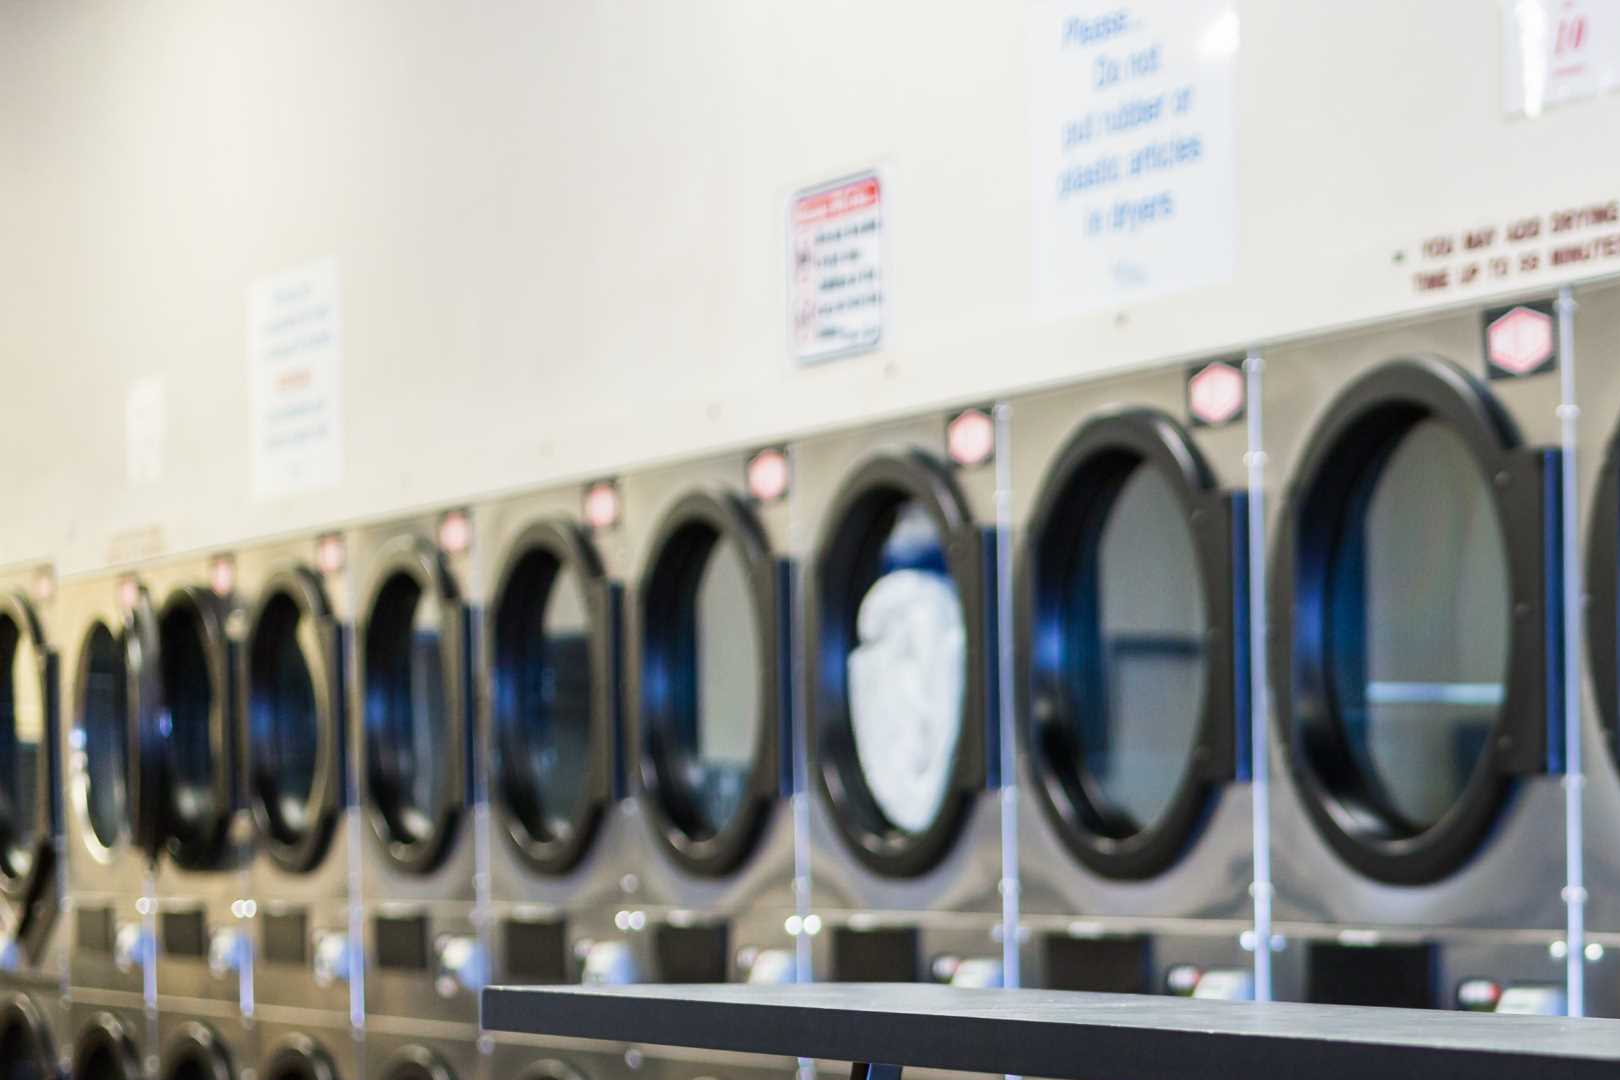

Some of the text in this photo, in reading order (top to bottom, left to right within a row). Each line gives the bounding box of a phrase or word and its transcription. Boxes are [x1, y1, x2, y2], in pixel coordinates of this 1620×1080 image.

[1103, 95, 1163, 132] rubber
[1057, 135, 1202, 200] plastic articles
[1423, 199, 1619, 257] YOU MAY ADD DRYING
[1413, 270, 1449, 290] TIME
[1459, 259, 1479, 284] UP
